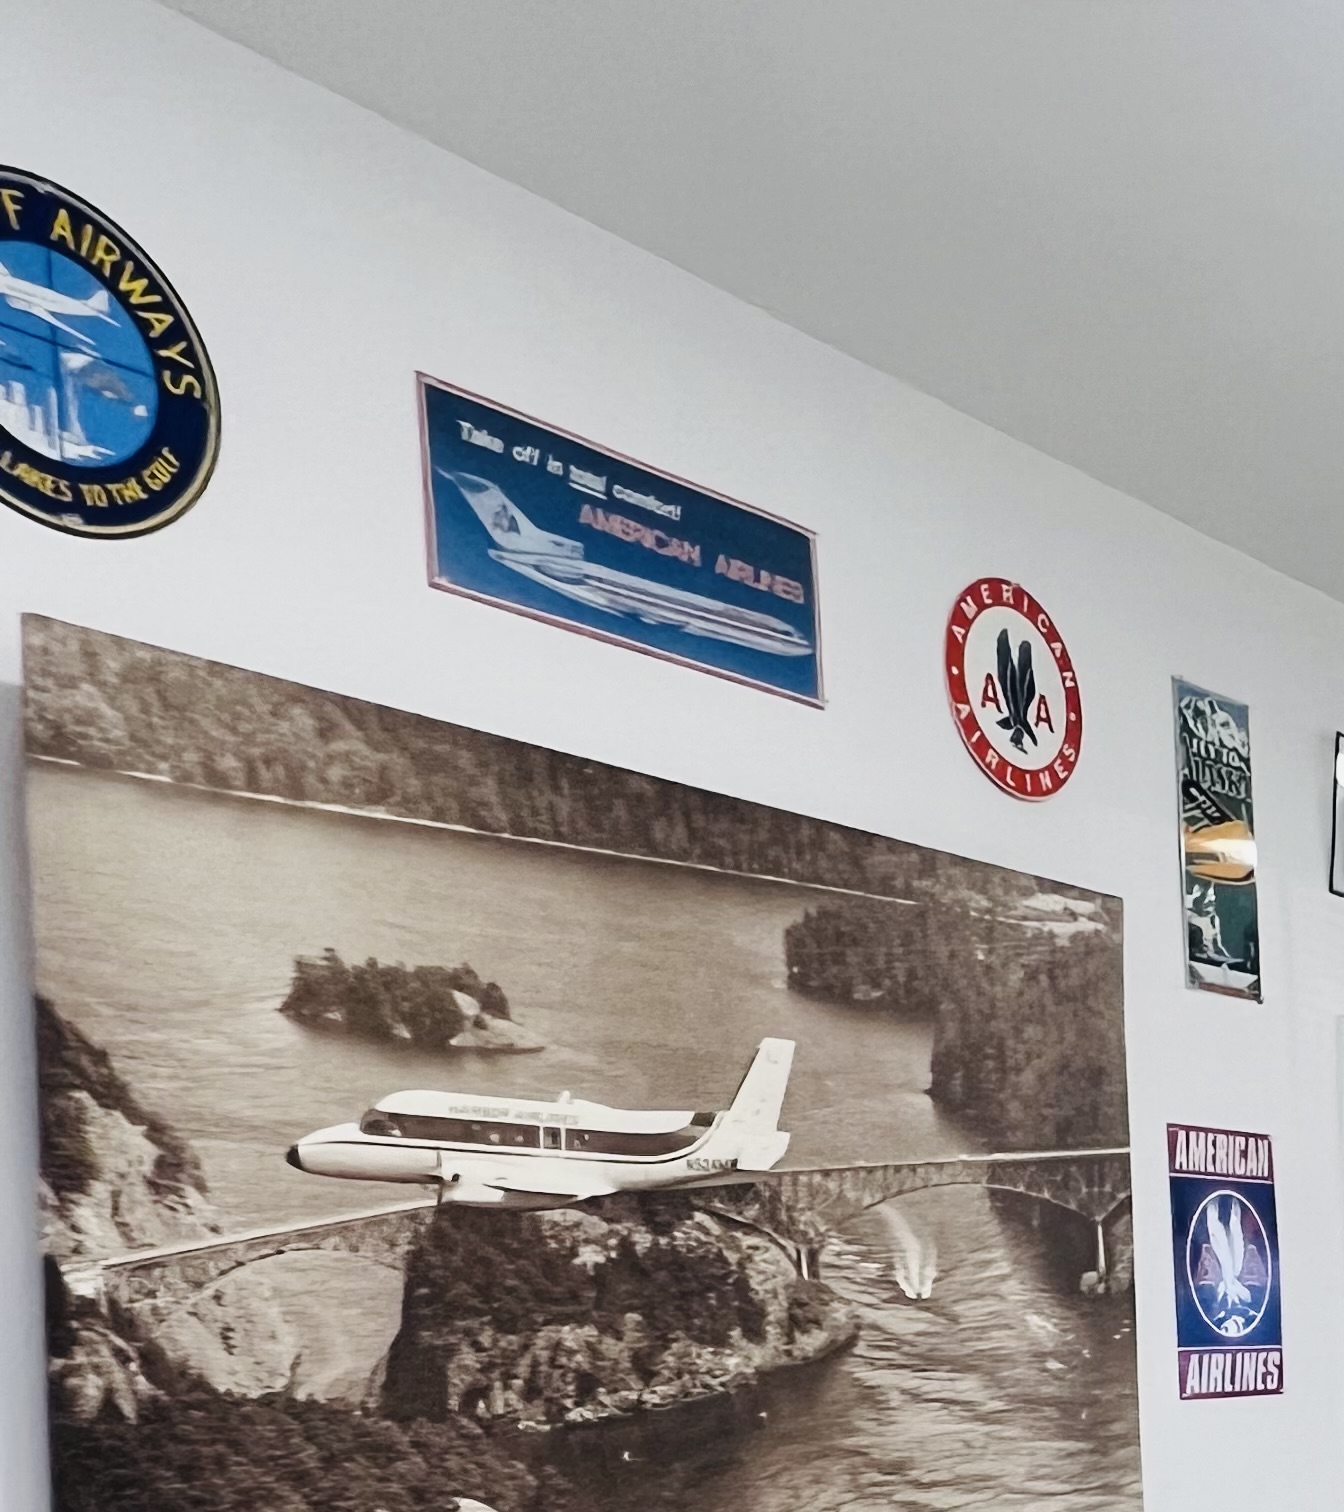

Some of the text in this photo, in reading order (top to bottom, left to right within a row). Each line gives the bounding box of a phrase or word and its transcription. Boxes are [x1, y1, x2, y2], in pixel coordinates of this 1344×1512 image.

[50, 208, 202, 399] AIRWAYS
[578, 503, 805, 605] AMERICAN AIRLINES
[951, 583, 1076, 688] AMERICAN
[951, 702, 1077, 792] AIRLINES
[1175, 1129, 1269, 1178] AMERICAN
[1185, 1351, 1281, 1394] AIRLINES
